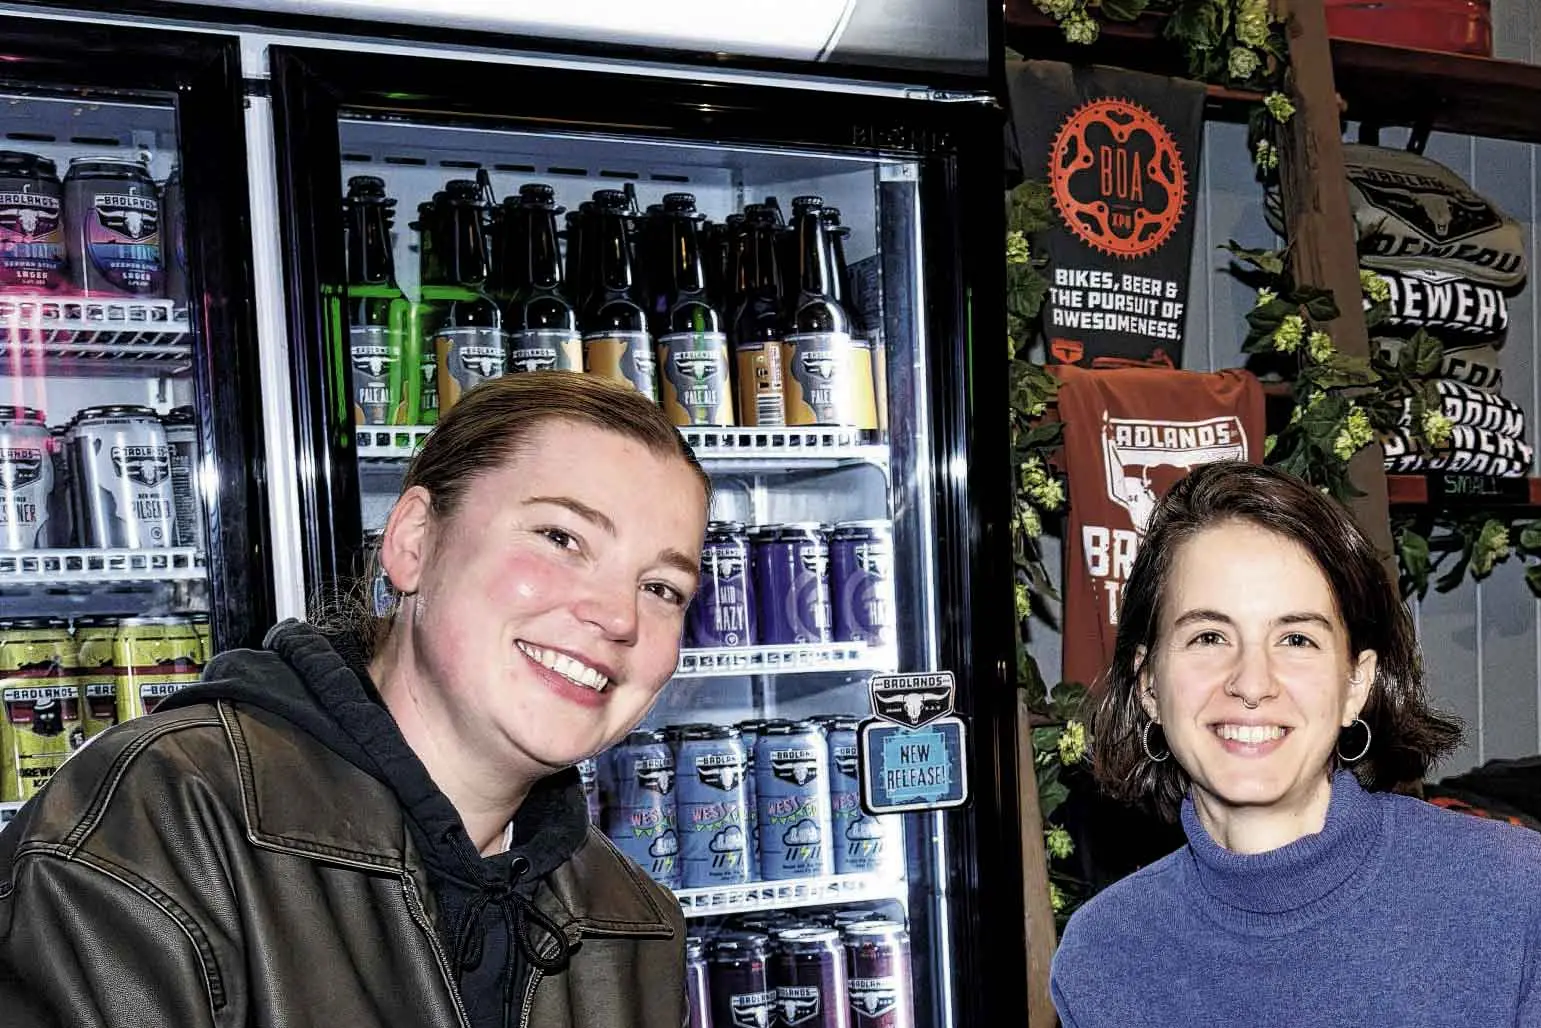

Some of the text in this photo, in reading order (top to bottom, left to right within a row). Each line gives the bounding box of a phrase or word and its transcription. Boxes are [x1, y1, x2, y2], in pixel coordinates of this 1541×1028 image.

[1100, 145, 1144, 201] BOA
[1055, 269, 1178, 298] BIKES, BEER &
[1050, 287, 1184, 319] THE PURSUIT OF
[1110, 424, 1232, 449] ADLANDS
[1083, 525, 1140, 580] BR
[13, 688, 73, 699] BADLANDS
[94, 685, 115, 695] BAD
[151, 684, 187, 695] BADLA
[884, 677, 943, 689] BADLANDS
[900, 743, 931, 765] NEW
[886, 765, 947, 791] RELEASE!
